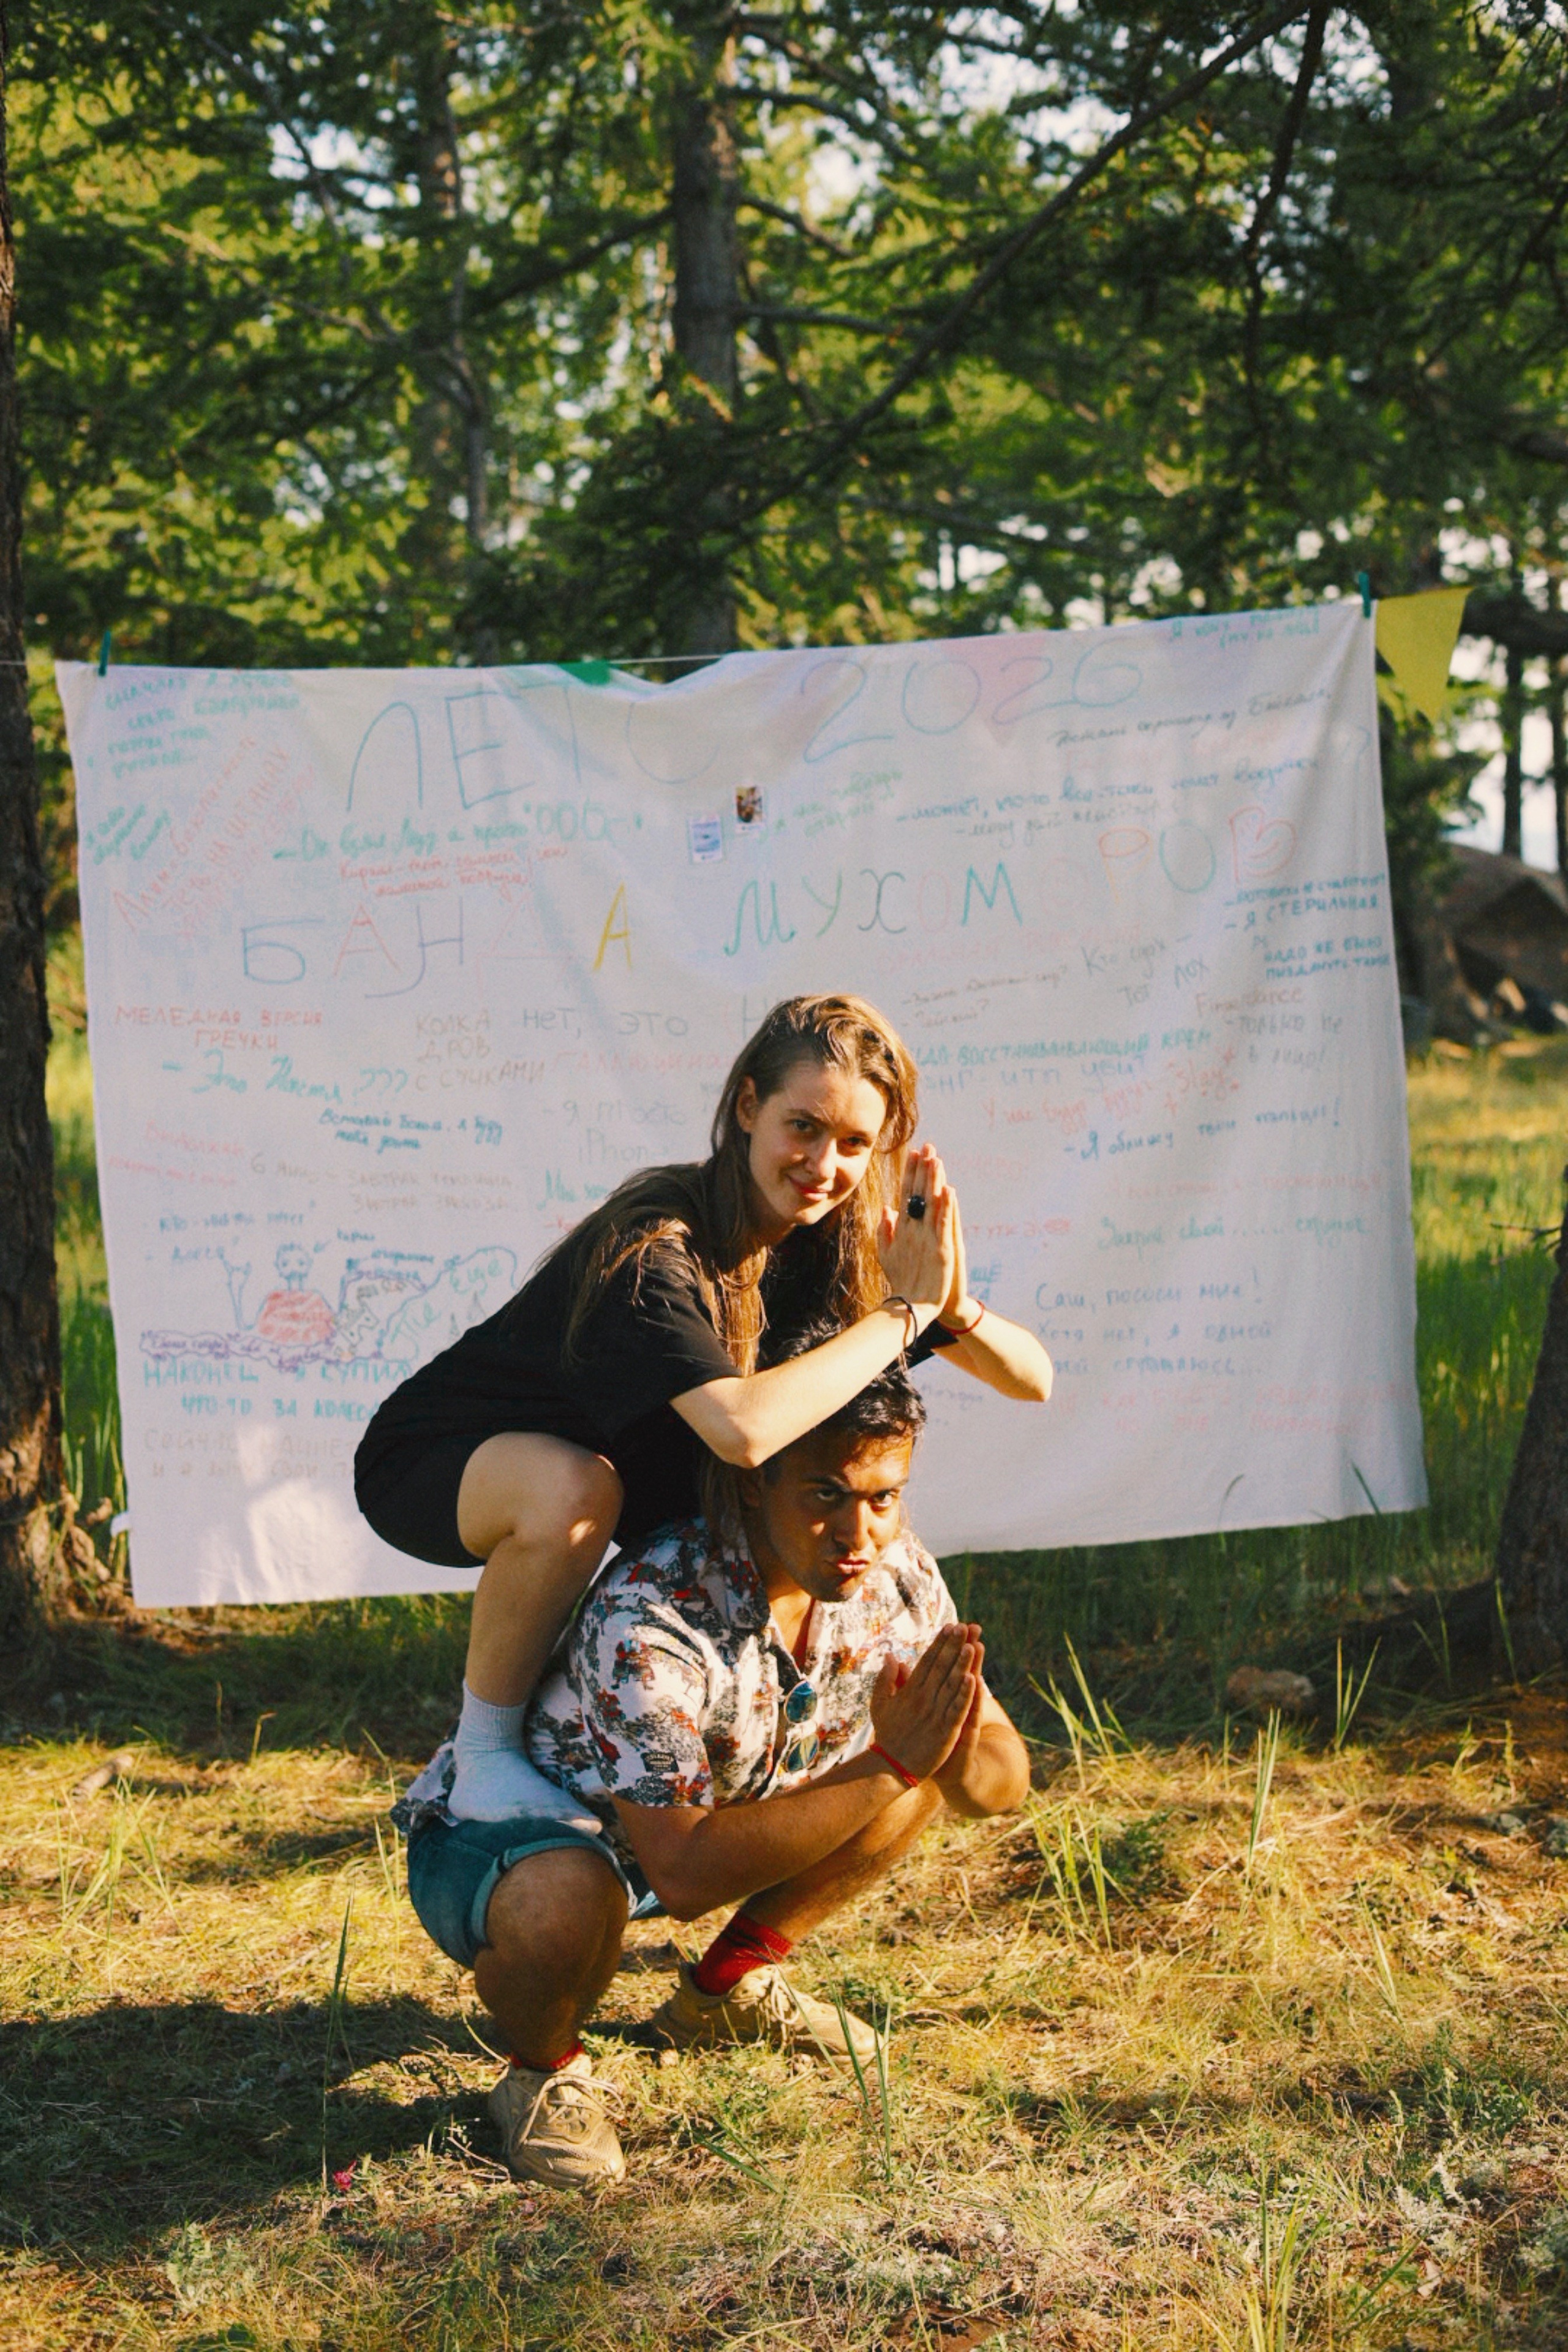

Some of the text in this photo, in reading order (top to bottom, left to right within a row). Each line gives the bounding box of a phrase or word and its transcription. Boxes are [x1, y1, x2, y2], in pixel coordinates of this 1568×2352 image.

[346, 676, 722, 813] ЛЕТО
[800, 636, 1142, 765] 2026
[723, 805, 1297, 957] МУХОМОРОВ
[243, 885, 635, 1000] БАНДА
[415, 1008, 490, 1036] КОЛКА
[522, 1008, 582, 1039] нет,
[195, 1028, 279, 1050] ГРЕЧКИ
[417, 1038, 491, 1063] ДРОВ
